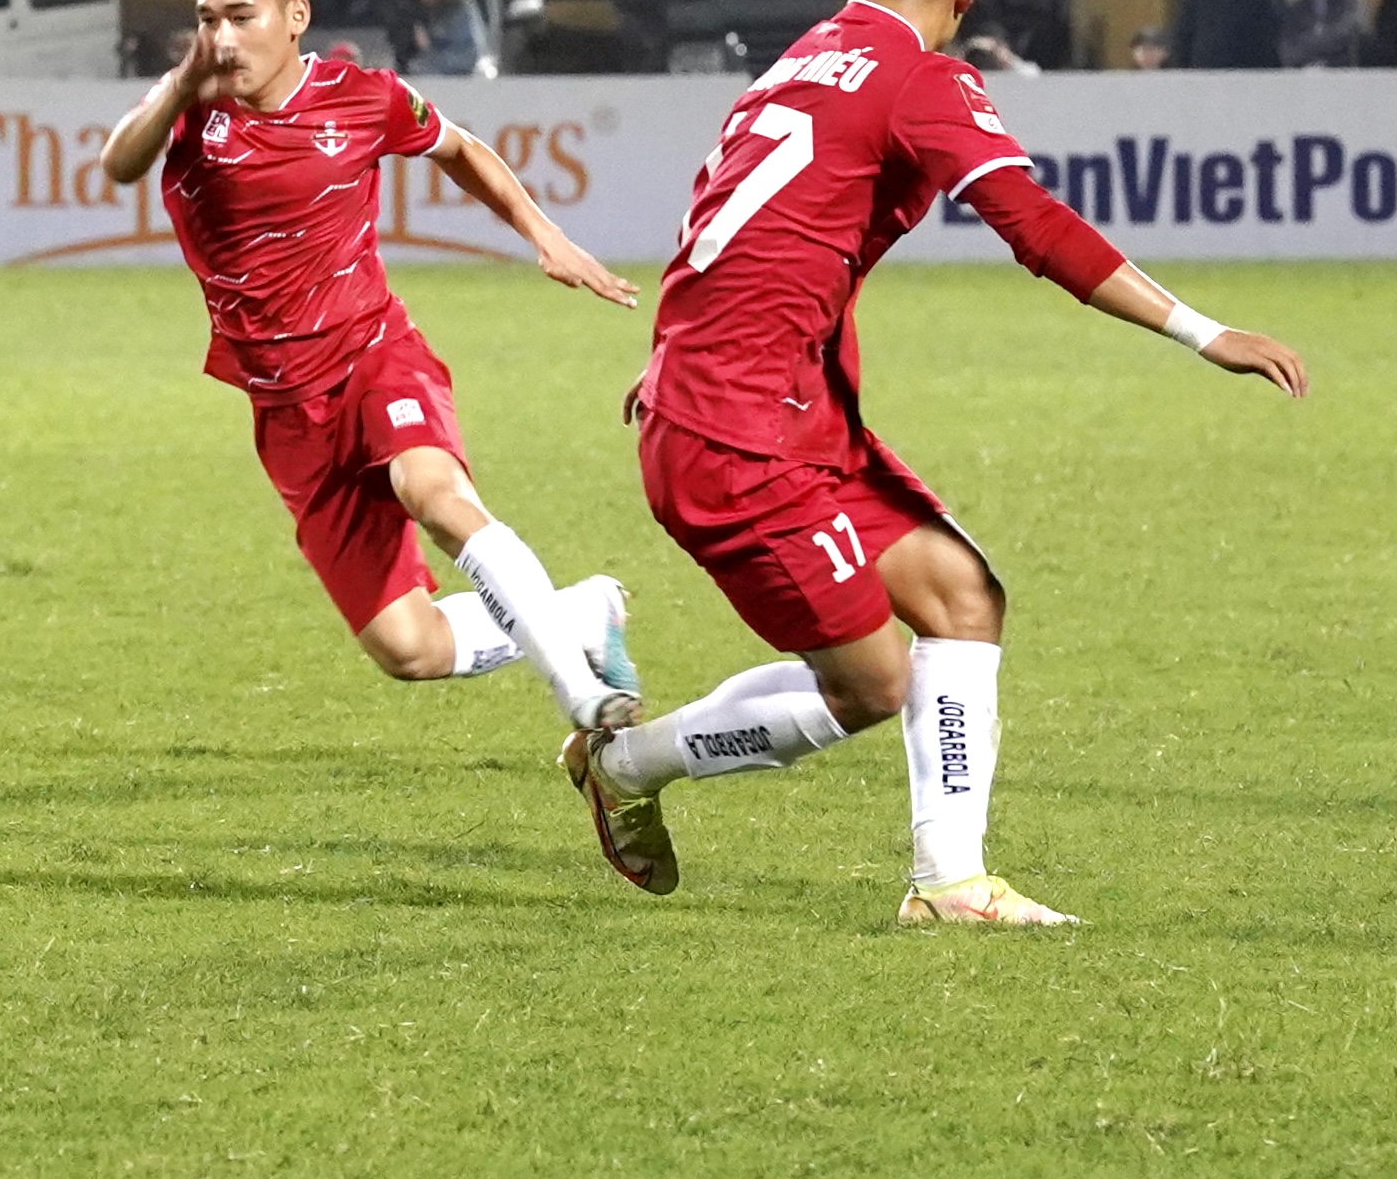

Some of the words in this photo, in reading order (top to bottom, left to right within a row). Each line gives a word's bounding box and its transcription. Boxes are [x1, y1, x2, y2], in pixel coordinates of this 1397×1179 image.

[812, 511, 866, 584] 17
[684, 725, 774, 760] JOGARBOLA
[937, 694, 972, 796] JOGARBOLA
